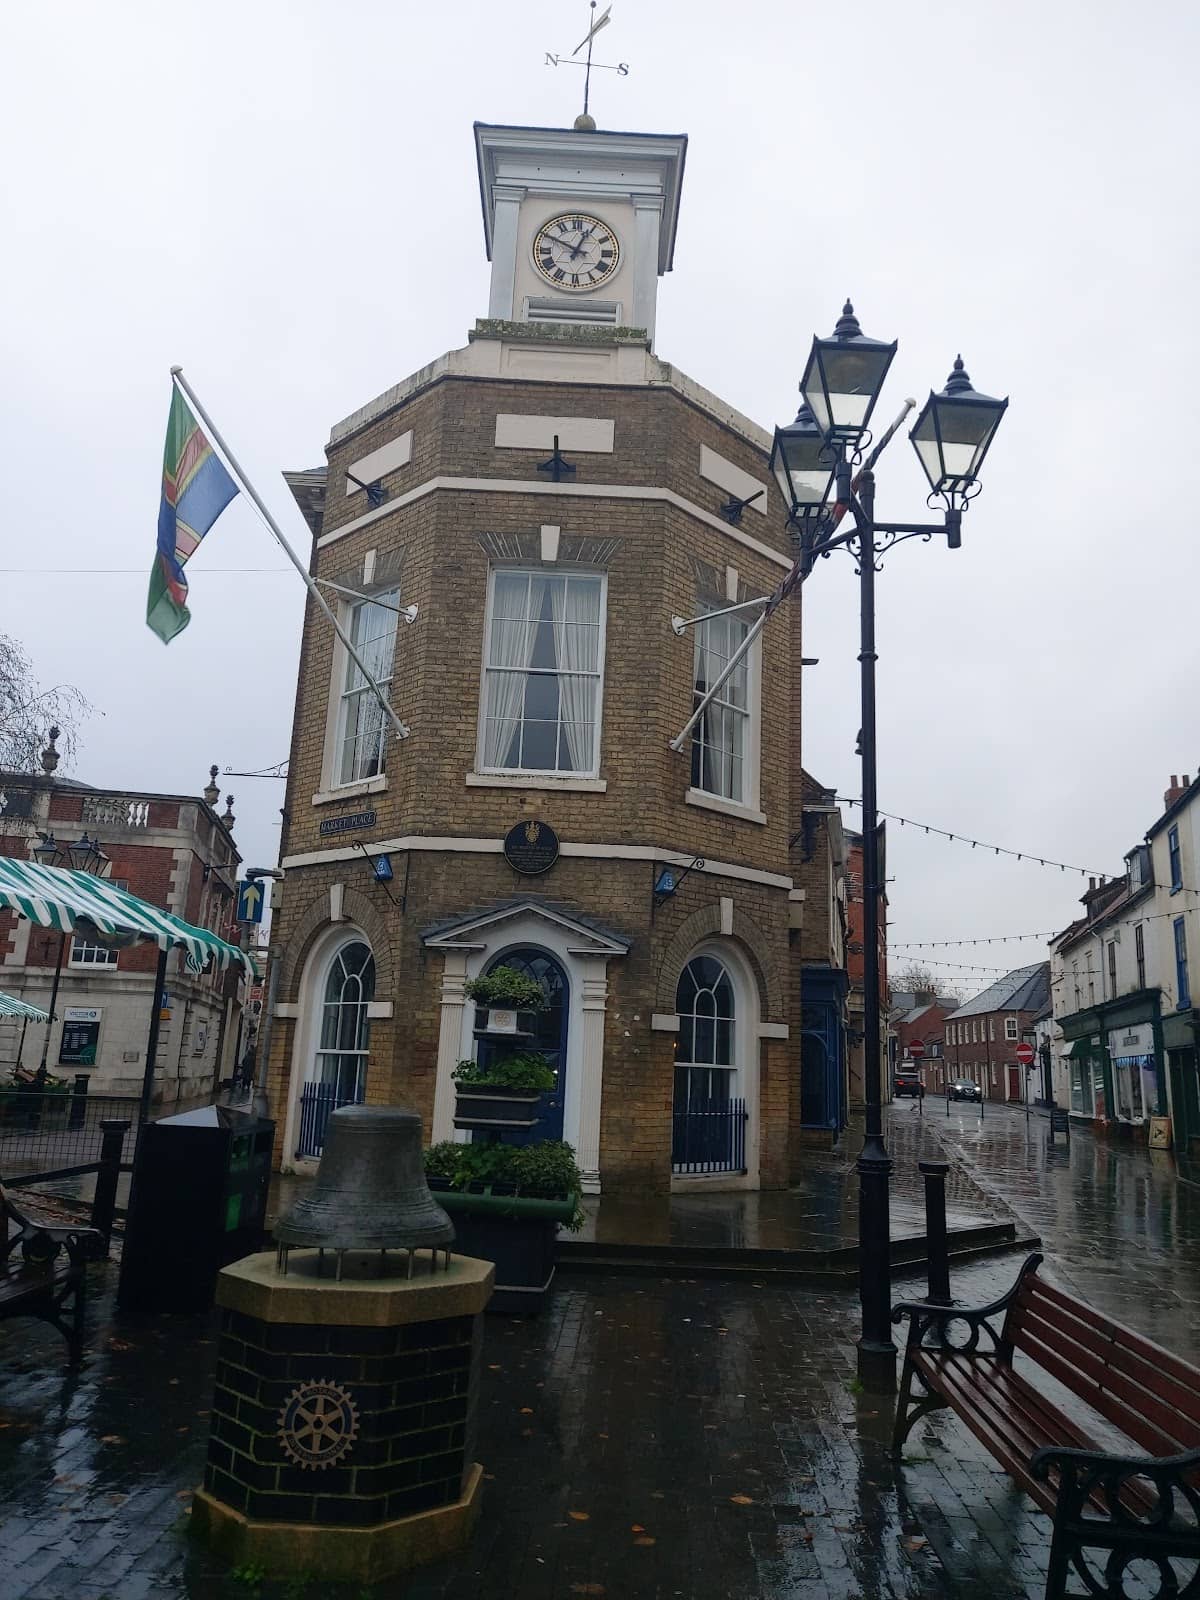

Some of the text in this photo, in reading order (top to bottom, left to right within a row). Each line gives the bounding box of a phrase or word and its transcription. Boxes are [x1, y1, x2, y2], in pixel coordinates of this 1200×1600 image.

[544, 52, 560, 67] N
[617, 62, 630, 76] S
[321, 814, 373, 832] MARKET PLACE
